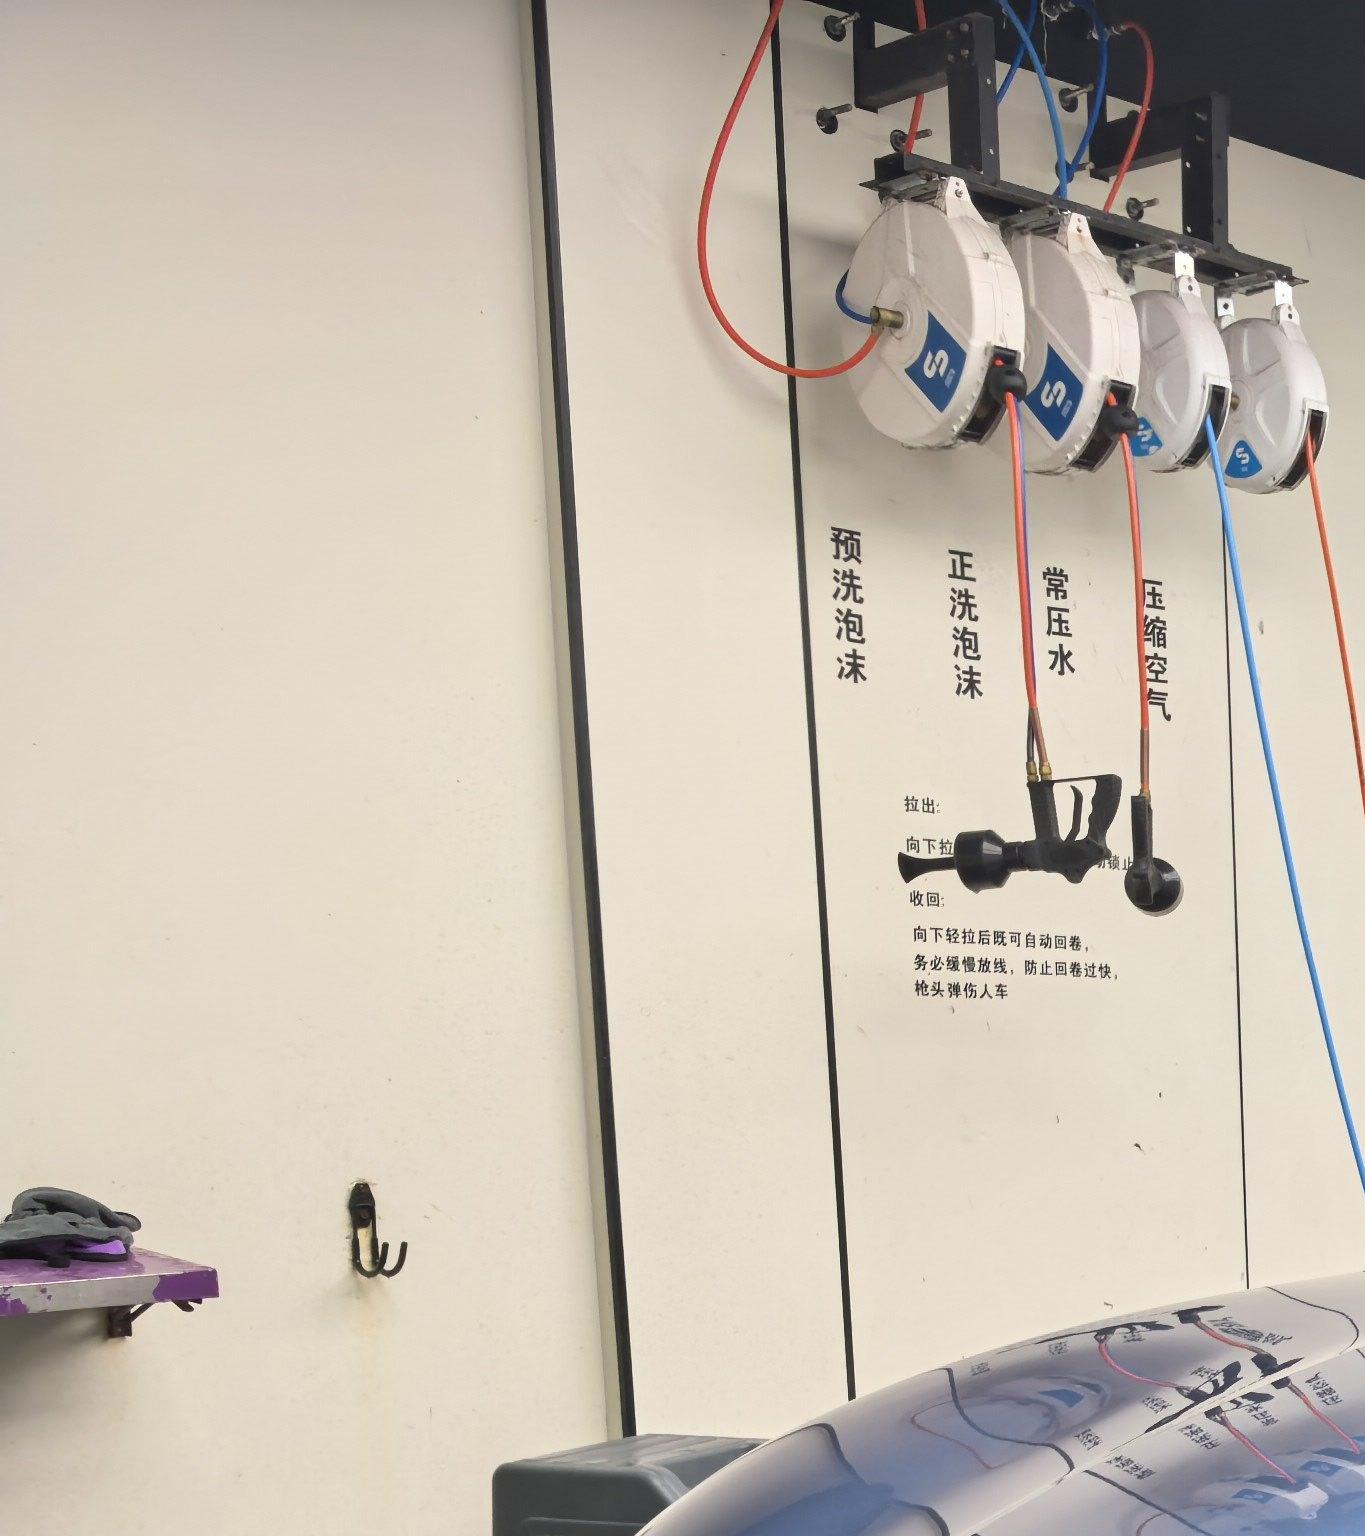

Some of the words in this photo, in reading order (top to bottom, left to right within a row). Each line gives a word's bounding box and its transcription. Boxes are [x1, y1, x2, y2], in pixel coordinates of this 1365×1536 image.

[830, 526, 867, 684] 预洗泡沫
[948, 548, 983, 700] 正洗泡沫
[1042, 566, 1076, 676] 常压水
[1142, 578, 1172, 722] 压缩空气
[914, 979, 1009, 1000] 枪头弹伤人车
